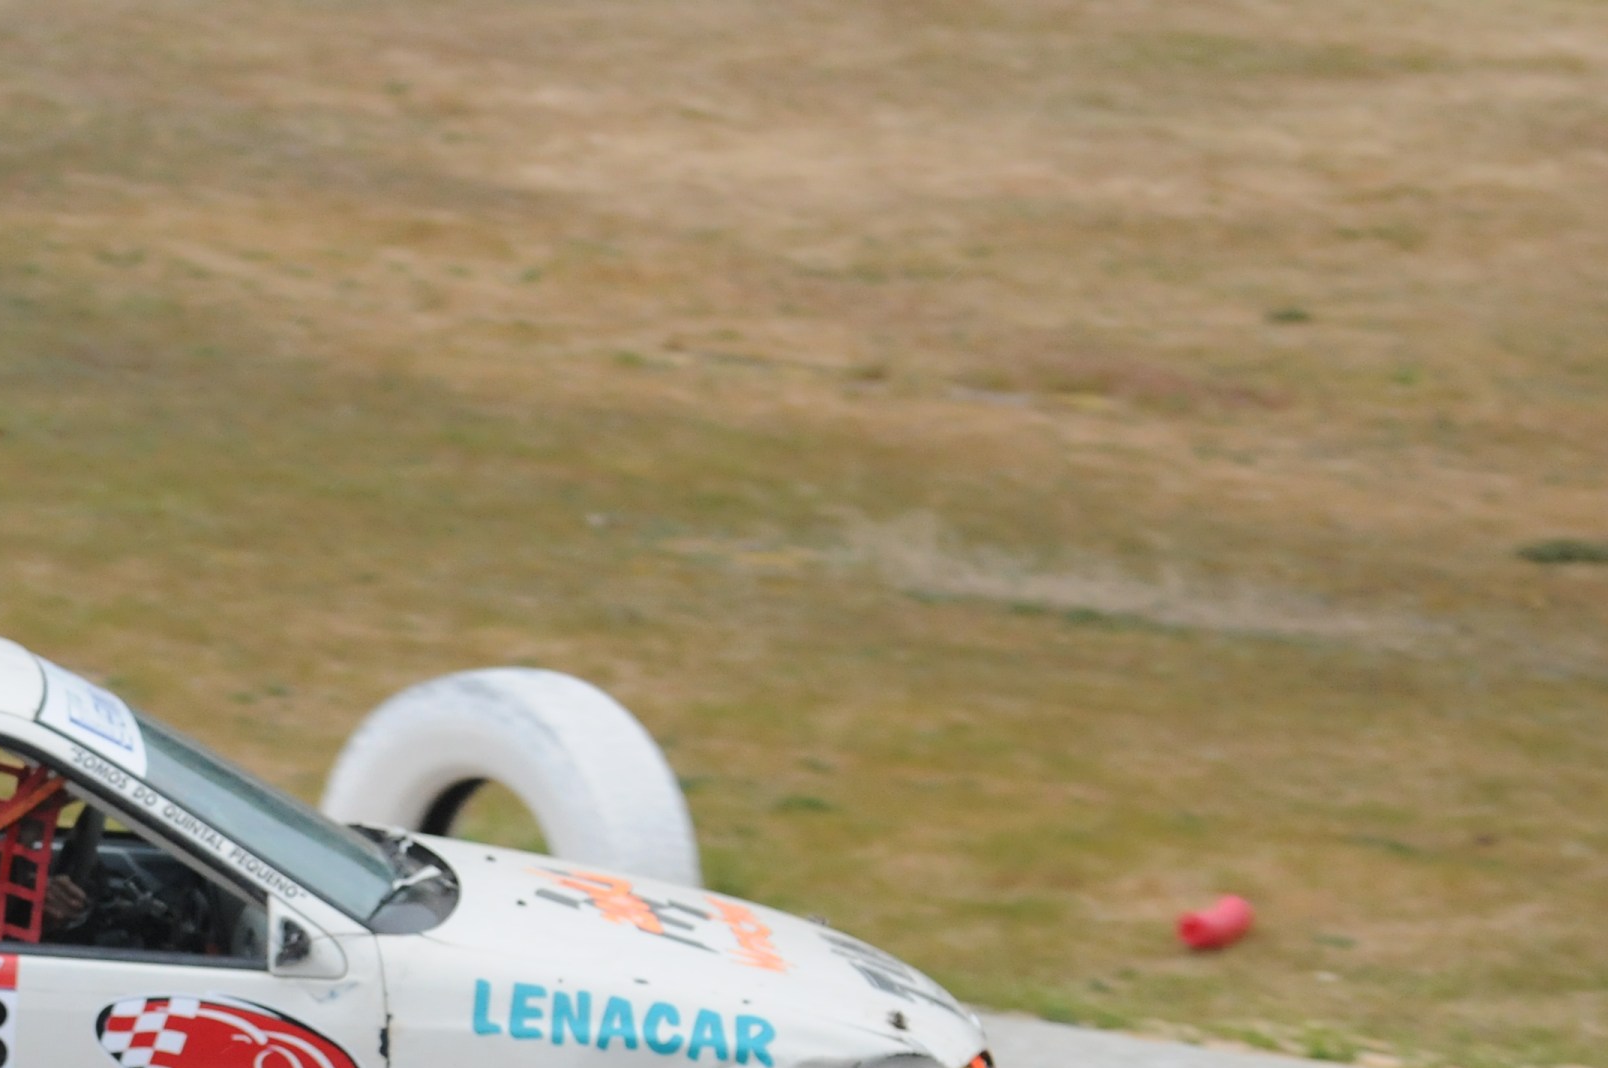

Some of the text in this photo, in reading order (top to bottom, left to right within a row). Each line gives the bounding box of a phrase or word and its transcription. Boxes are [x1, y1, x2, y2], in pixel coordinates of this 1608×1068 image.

[133, 785, 159, 808] DO
[163, 801, 224, 851] QUINTAL
[472, 978, 777, 1068] LENACAR
